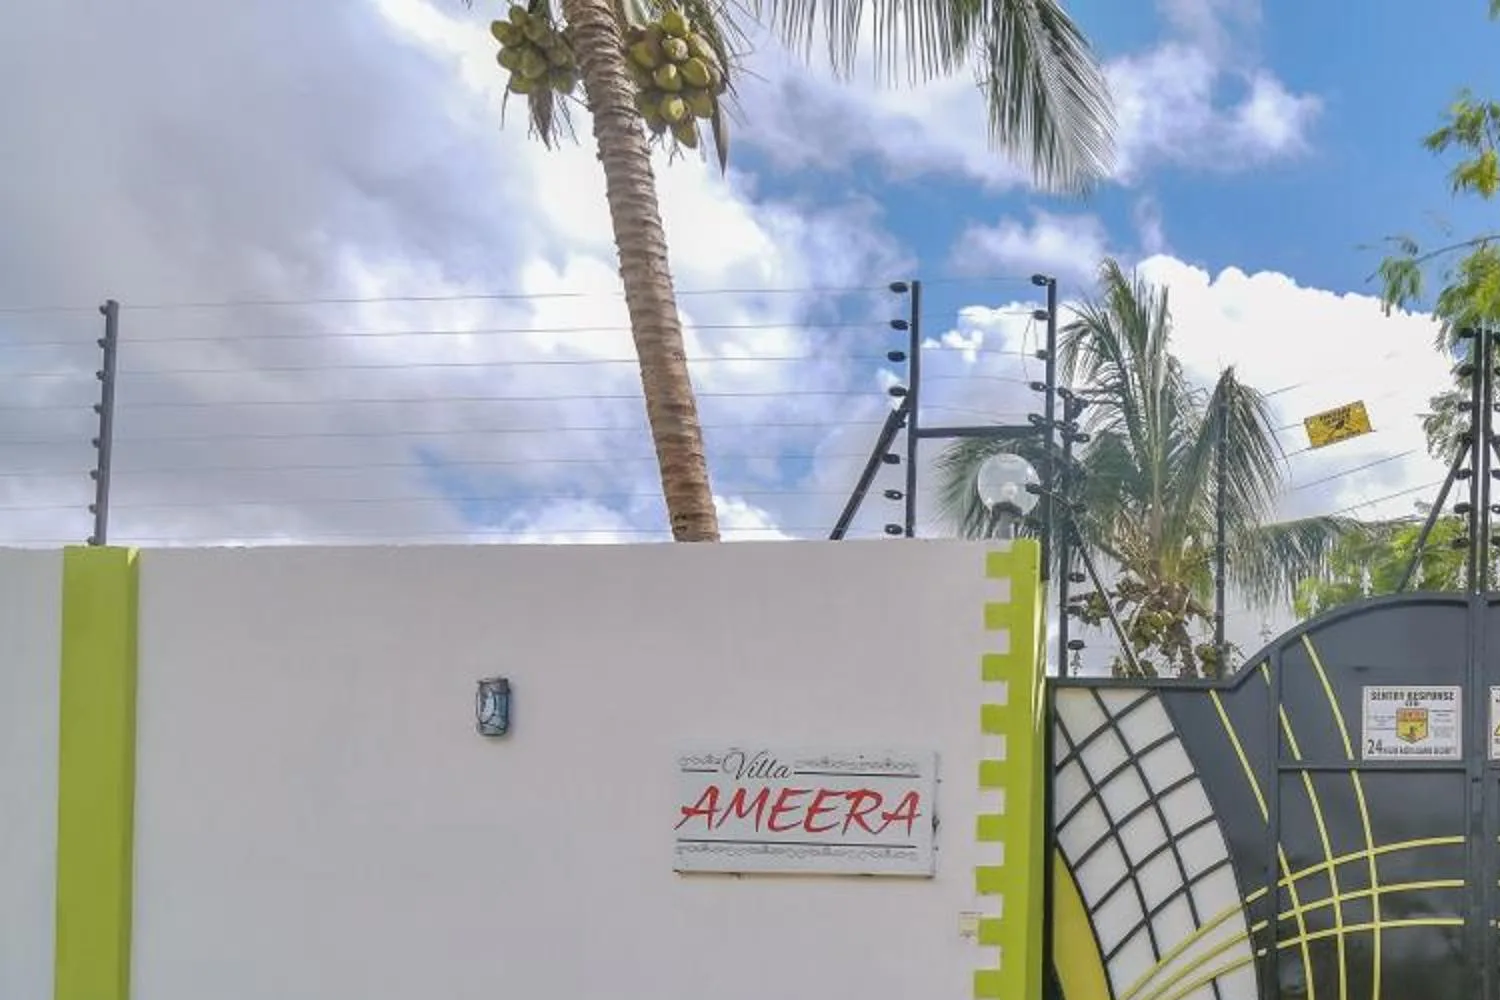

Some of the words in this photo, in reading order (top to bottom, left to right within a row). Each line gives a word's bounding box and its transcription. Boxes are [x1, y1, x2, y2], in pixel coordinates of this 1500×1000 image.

[1407, 690, 1455, 701] RESPONSE
[1367, 739, 1383, 755] 24
[722, 750, 793, 780] Villa
[674, 784, 922, 836] AMEERA
